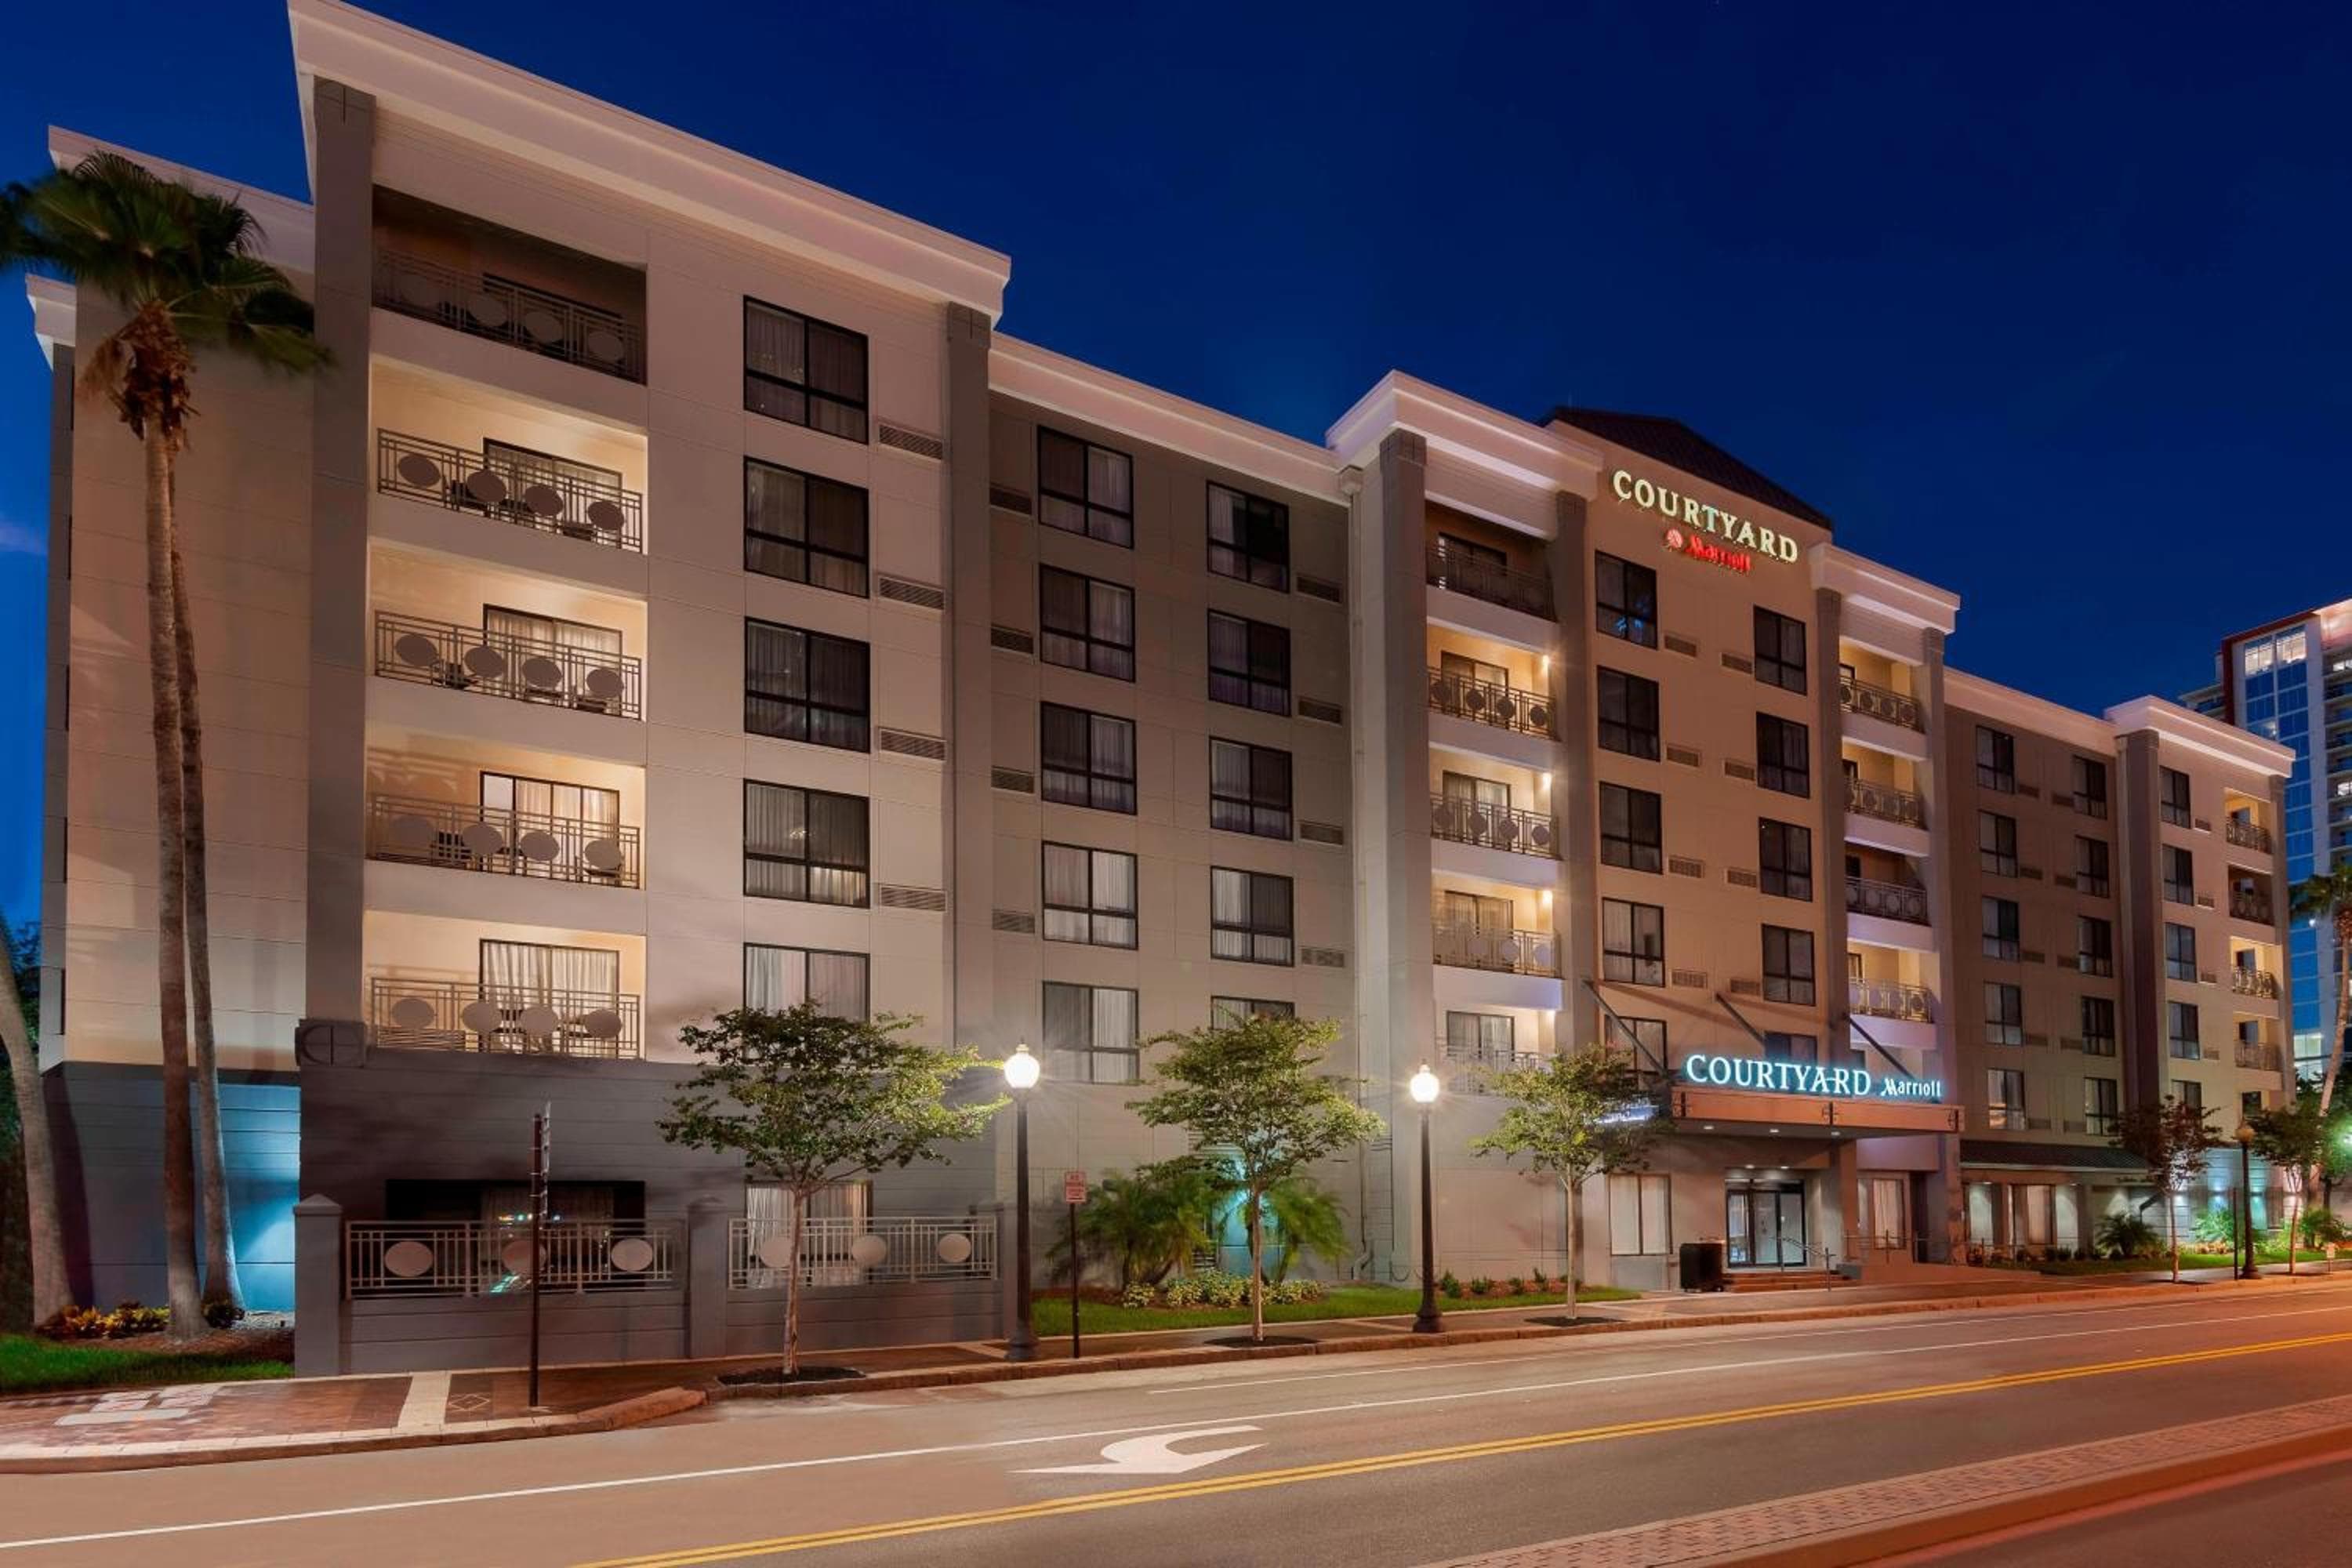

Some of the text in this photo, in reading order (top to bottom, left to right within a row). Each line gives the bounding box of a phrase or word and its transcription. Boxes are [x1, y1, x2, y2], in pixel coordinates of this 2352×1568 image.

[1613, 470, 1798, 564] COURTYARD
[1686, 1054, 1941, 1098] COURTYARD Marriott
